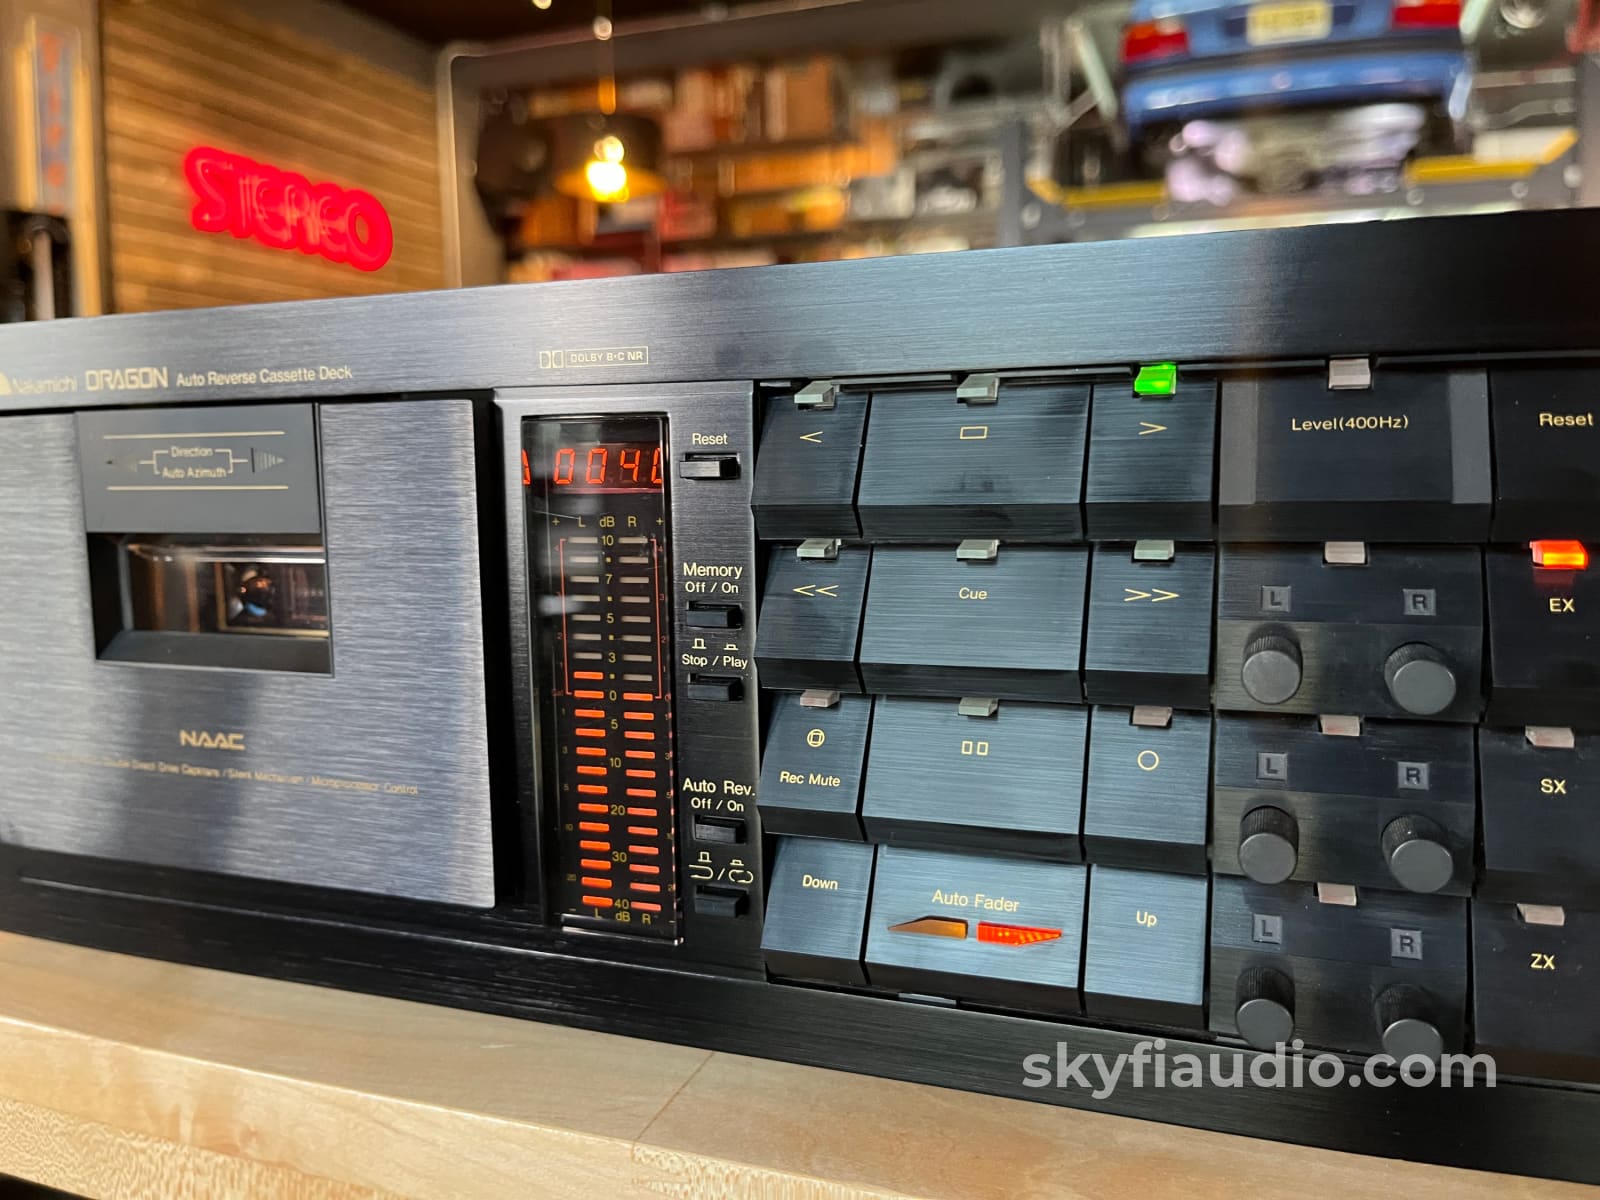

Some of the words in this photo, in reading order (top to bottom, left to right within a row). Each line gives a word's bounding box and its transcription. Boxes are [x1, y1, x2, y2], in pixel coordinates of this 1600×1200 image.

[184, 146, 393, 271] STEREO
[570, 353, 603, 363] DOLBY
[627, 351, 644, 361] NR
[176, 373, 205, 387] Auto
[207, 370, 257, 385] Reverse
[259, 366, 316, 383] Cassette
[319, 365, 353, 380] Deck
[1291, 414, 1409, 432] Level(400Hz)
[1540, 413, 1593, 427] Reset
[691, 432, 728, 445] Reset
[170, 445, 214, 458] Direction
[161, 466, 185, 478] Auto
[187, 466, 227, 479] Azimuth
[578, 516, 586, 528] L
[599, 516, 615, 528] dB
[627, 516, 637, 528] R
[601, 535, 614, 546] 10
[683, 562, 743, 580] Memory
[605, 573, 613, 584] 7
[685, 581, 706, 593] Off
[721, 582, 739, 594] On
[959, 586, 987, 600] Cue
[1549, 598, 1575, 612] EX
[606, 613, 615, 624] 5
[608, 652, 616, 663] 3
[681, 654, 708, 667] Stop
[723, 655, 748, 669] Play
[609, 690, 617, 701] 0
[611, 718, 619, 730] 5
[180, 730, 245, 750] NAAC
[609, 757, 622, 769] 10
[779, 771, 804, 785] Rec
[808, 773, 841, 787] Mute
[683, 777, 716, 793] Auto
[723, 780, 756, 796] Rev.
[1540, 779, 1567, 794] SX
[610, 804, 626, 816] 20
[691, 797, 712, 809] Off
[727, 800, 744, 812] On
[612, 852, 628, 863] 30
[802, 874, 838, 890] Down
[614, 899, 630, 910] 40
[932, 889, 968, 907] Auto
[974, 894, 1019, 912] Fader
[615, 911, 631, 922] dB
[642, 914, 651, 925] R
[1136, 911, 1157, 927] Up
[1530, 953, 1556, 970] ZX
